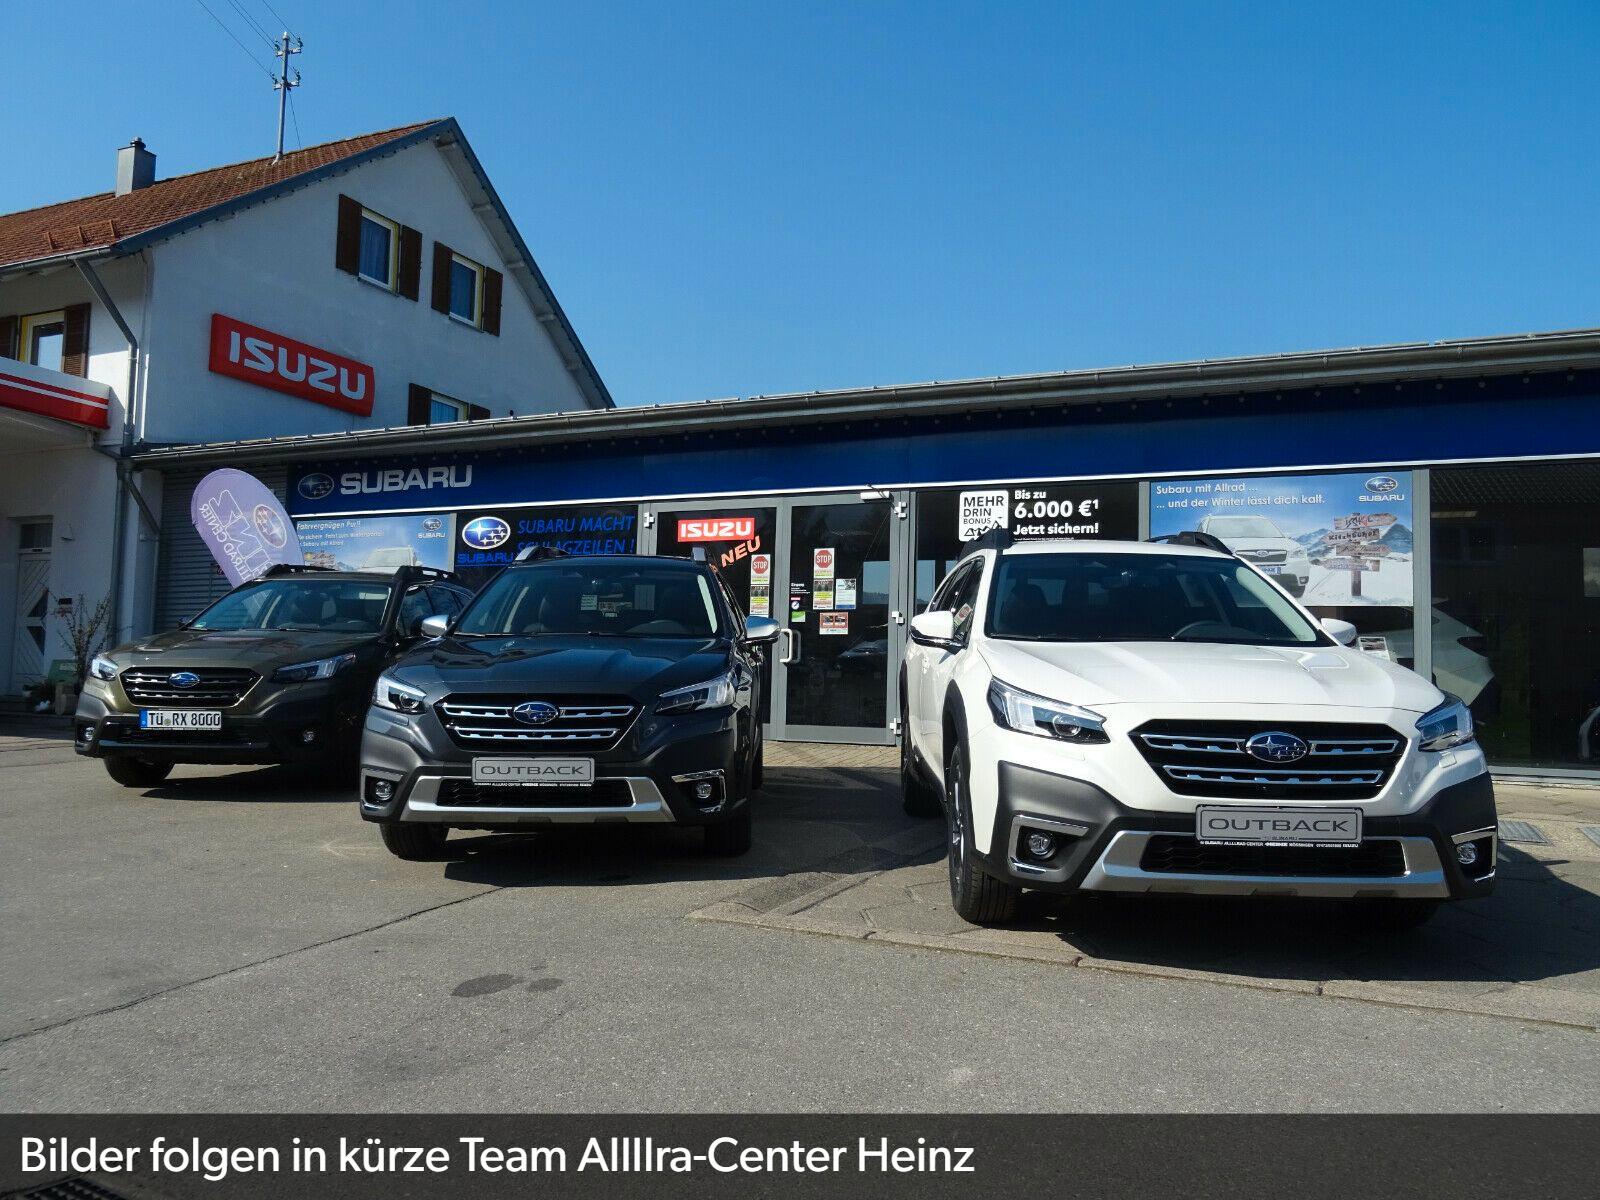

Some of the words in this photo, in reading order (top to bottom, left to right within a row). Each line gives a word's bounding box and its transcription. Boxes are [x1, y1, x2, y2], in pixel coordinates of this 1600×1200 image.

[229, 331, 366, 400] ISUZU
[340, 465, 472, 495] SUBARU
[1014, 490, 1031, 499] Bis
[1033, 491, 1046, 499] zu
[1156, 486, 1192, 494] Subaru
[1195, 484, 1211, 493] mit
[1214, 483, 1246, 492] Allrad
[963, 496, 1004, 508] MEHR
[1168, 499, 1188, 508] und
[1190, 498, 1208, 508] der
[1211, 497, 1245, 507] Winter
[1273, 495, 1299, 505] dich
[1301, 494, 1325, 504] kalt.
[963, 508, 992, 517] DRIN
[1014, 500, 1073, 518] 6.000
[518, 518, 576, 534] SUBARU
[578, 516, 635, 532] MACHT
[681, 521, 752, 538] ISUZU
[1013, 524, 1046, 535] Jetzt
[1047, 523, 1099, 535] sichern!
[457, 552, 514, 564] SUBARU
[721, 536, 761, 568] NEU
[752, 561, 768, 569] STOP
[816, 555, 832, 563] STOP
[149, 713, 164, 725] TÜ
[172, 713, 187, 726] RX
[191, 713, 220, 726] 8000
[481, 766, 584, 775] OUTBACK
[1208, 818, 1349, 832] OUTBACK
